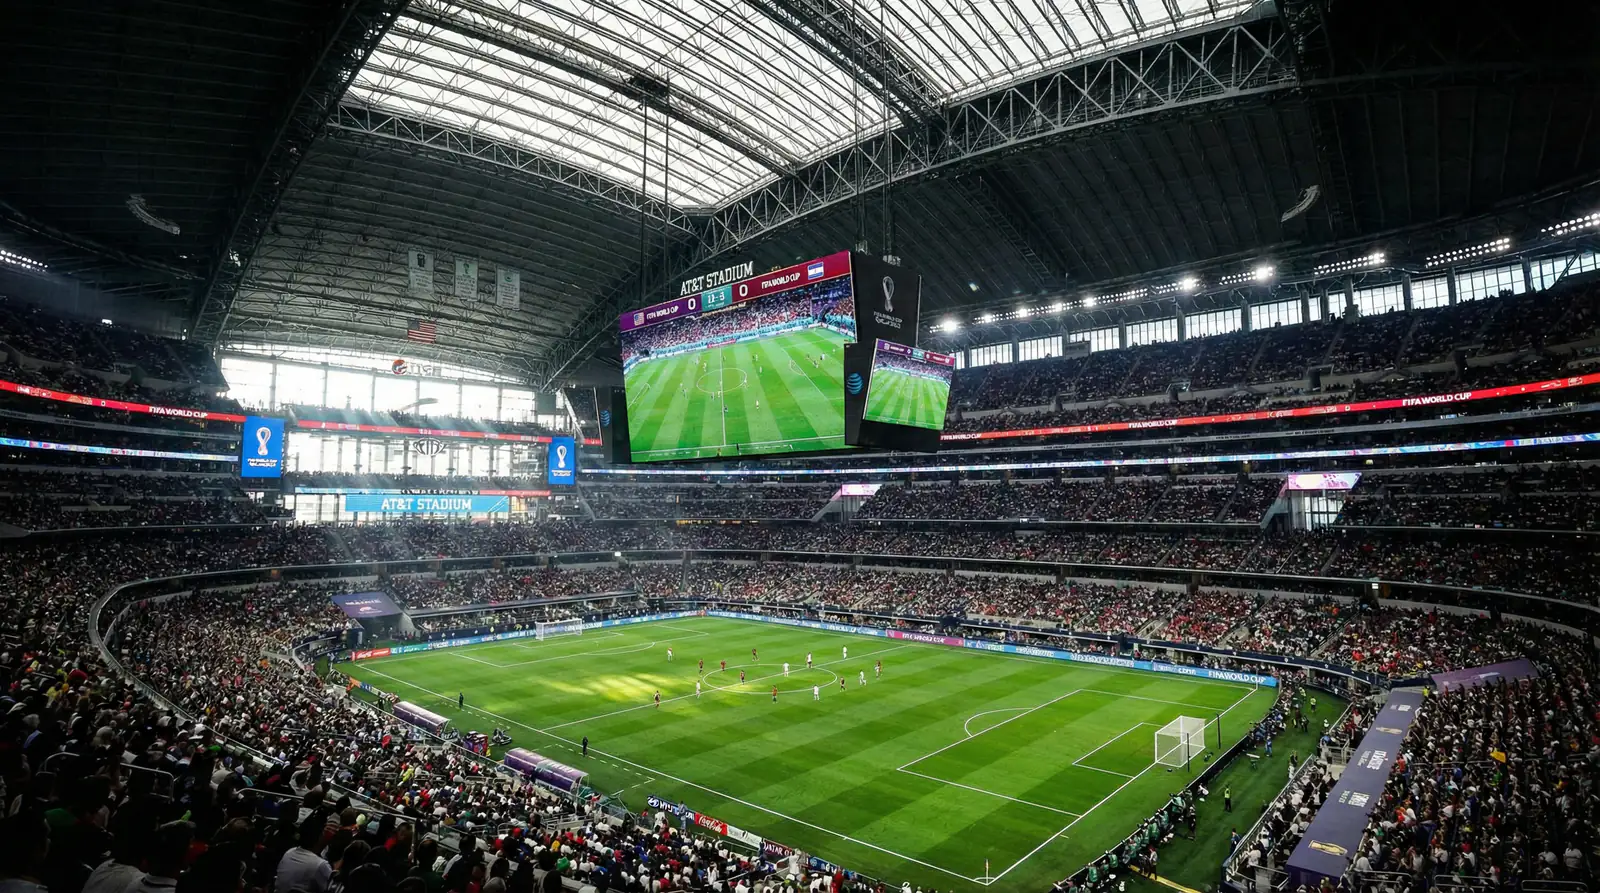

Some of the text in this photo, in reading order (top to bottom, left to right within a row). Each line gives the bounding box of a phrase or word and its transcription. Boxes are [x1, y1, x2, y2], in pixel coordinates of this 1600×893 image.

[680, 261, 753, 296] AT&T STADIUM
[739, 284, 748, 297] 0
[688, 298, 696, 310] 0
[1402, 392, 1472, 407] FIFA WORLD CUP
[165, 408, 193, 417] WORLD
[381, 498, 472, 510] AT&T STADIUM
